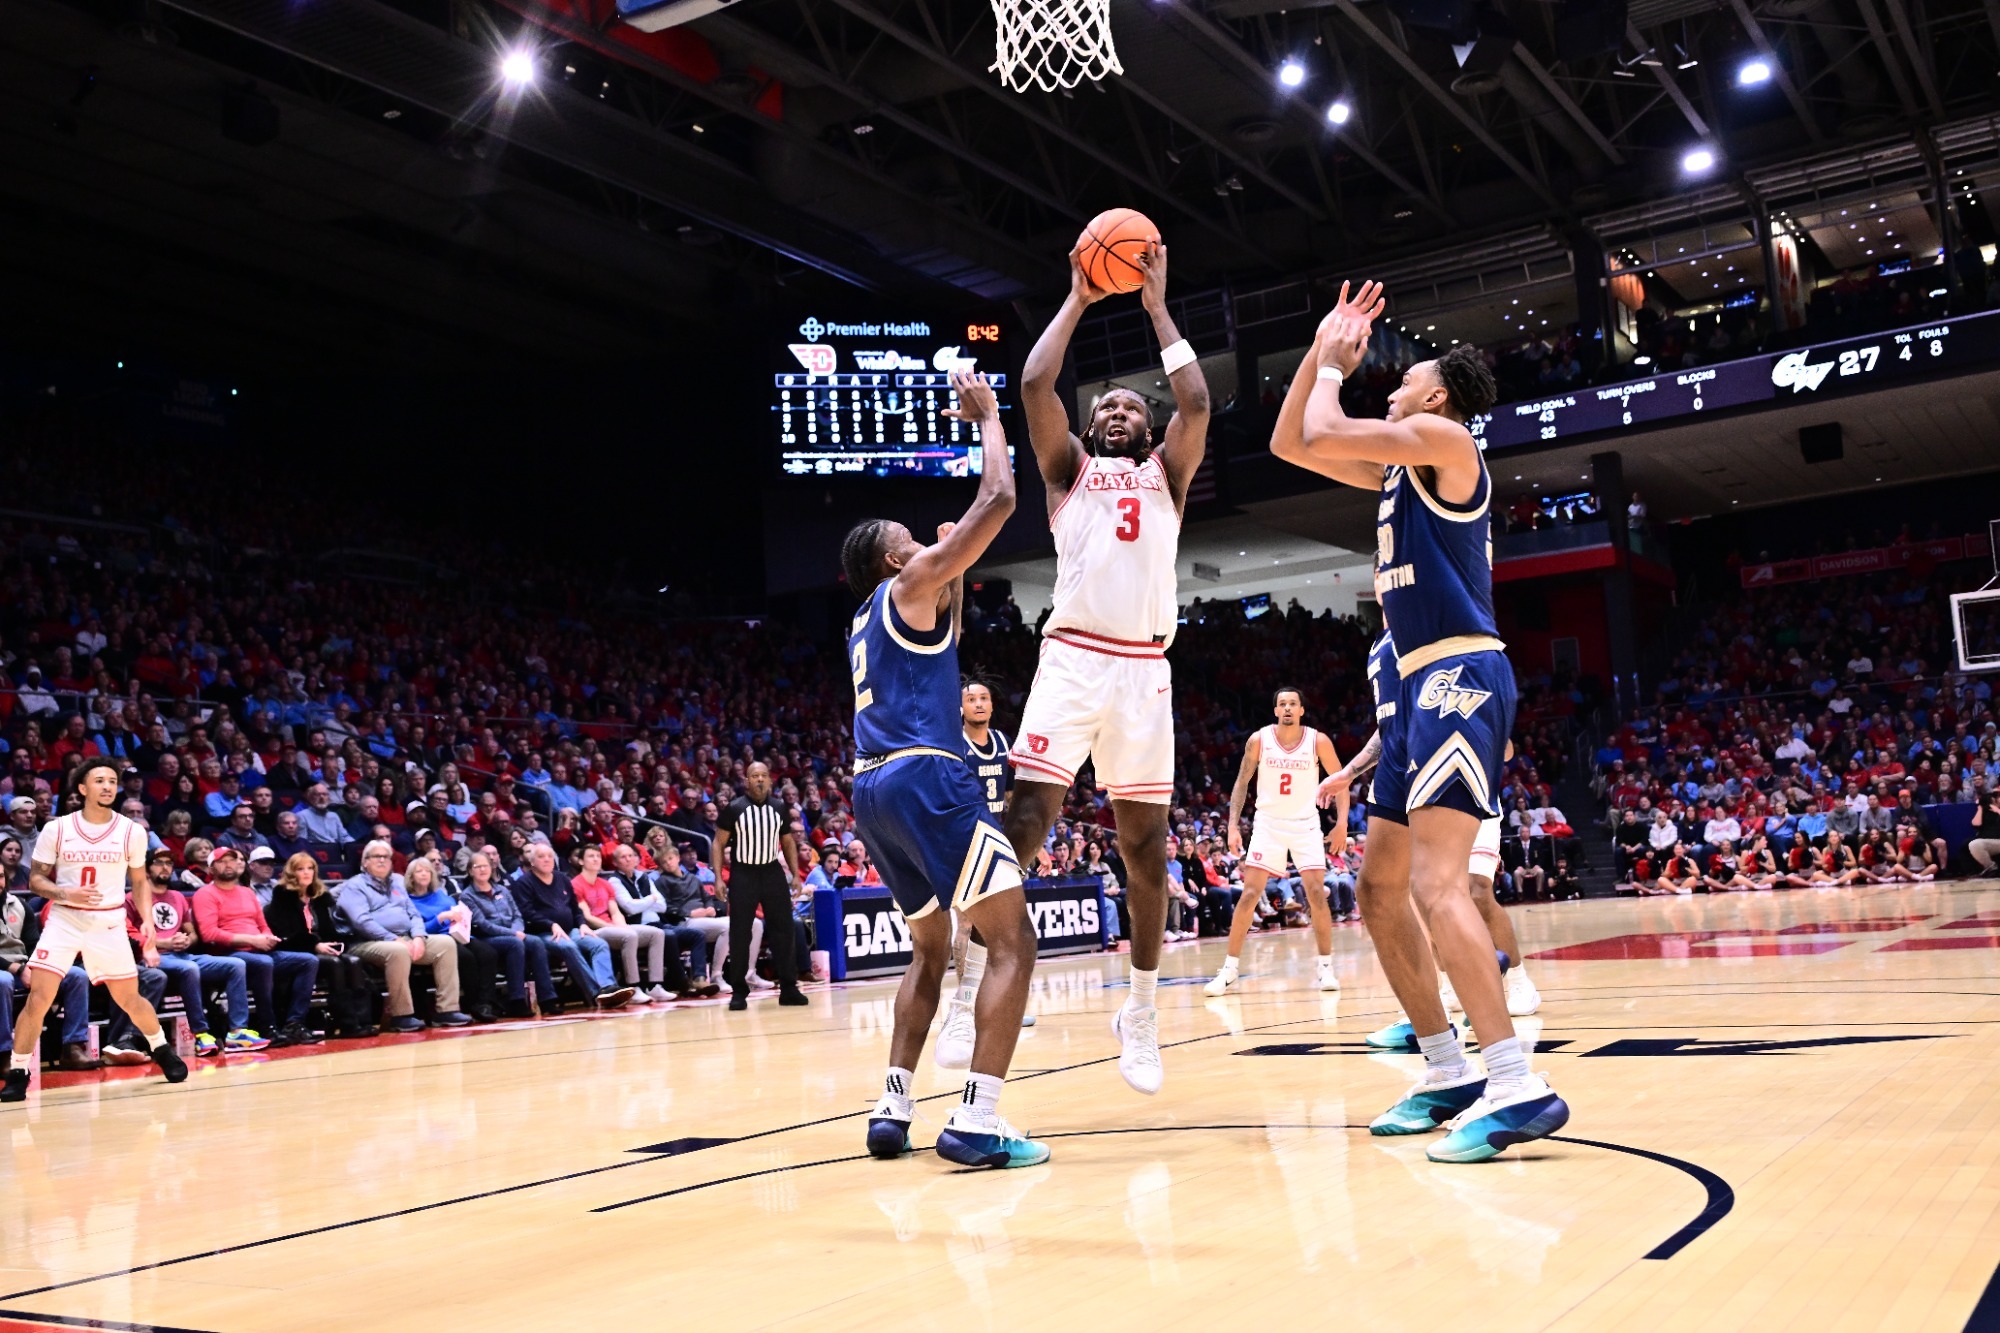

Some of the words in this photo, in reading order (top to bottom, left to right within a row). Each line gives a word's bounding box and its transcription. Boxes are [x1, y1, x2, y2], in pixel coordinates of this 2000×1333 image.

[827, 322, 882, 335] Premier
[884, 322, 930, 336] Health
[968, 325, 999, 341] 8:42
[1918, 323, 1949, 339] FOULS
[1899, 345, 1912, 361] 4
[1931, 340, 1943, 356] 8
[1839, 346, 1881, 376] 27
[1677, 370, 1716, 385] BLOCKS
[1597, 388, 1623, 401] TURN
[1623, 381, 1656, 396] OVERS
[1694, 383, 1701, 395] 1
[1516, 403, 1541, 416] FIELD
[1542, 399, 1566, 410] GOAL
[1566, 396, 1576, 406] %
[1621, 396, 1630, 408] 7
[1694, 397, 1703, 411] 0
[1539, 410, 1555, 423] 43
[1622, 412, 1632, 425] 5
[1471, 422, 1486, 436] 27
[1541, 426, 1556, 440] 32
[1116, 498, 1140, 541] 3
[1819, 554, 1879, 571] DAVIDSON
[852, 638, 874, 714] 2
[978, 764, 1003, 777] GEORGE
[1265, 757, 1311, 771] DAYTON
[986, 778, 997, 800] 3
[1280, 773, 1292, 795] 2
[62, 851, 122, 863] DAYTON
[80, 866, 97, 888] 0
[842, 911, 914, 958] DAY
[1025, 898, 1100, 939] YERS
